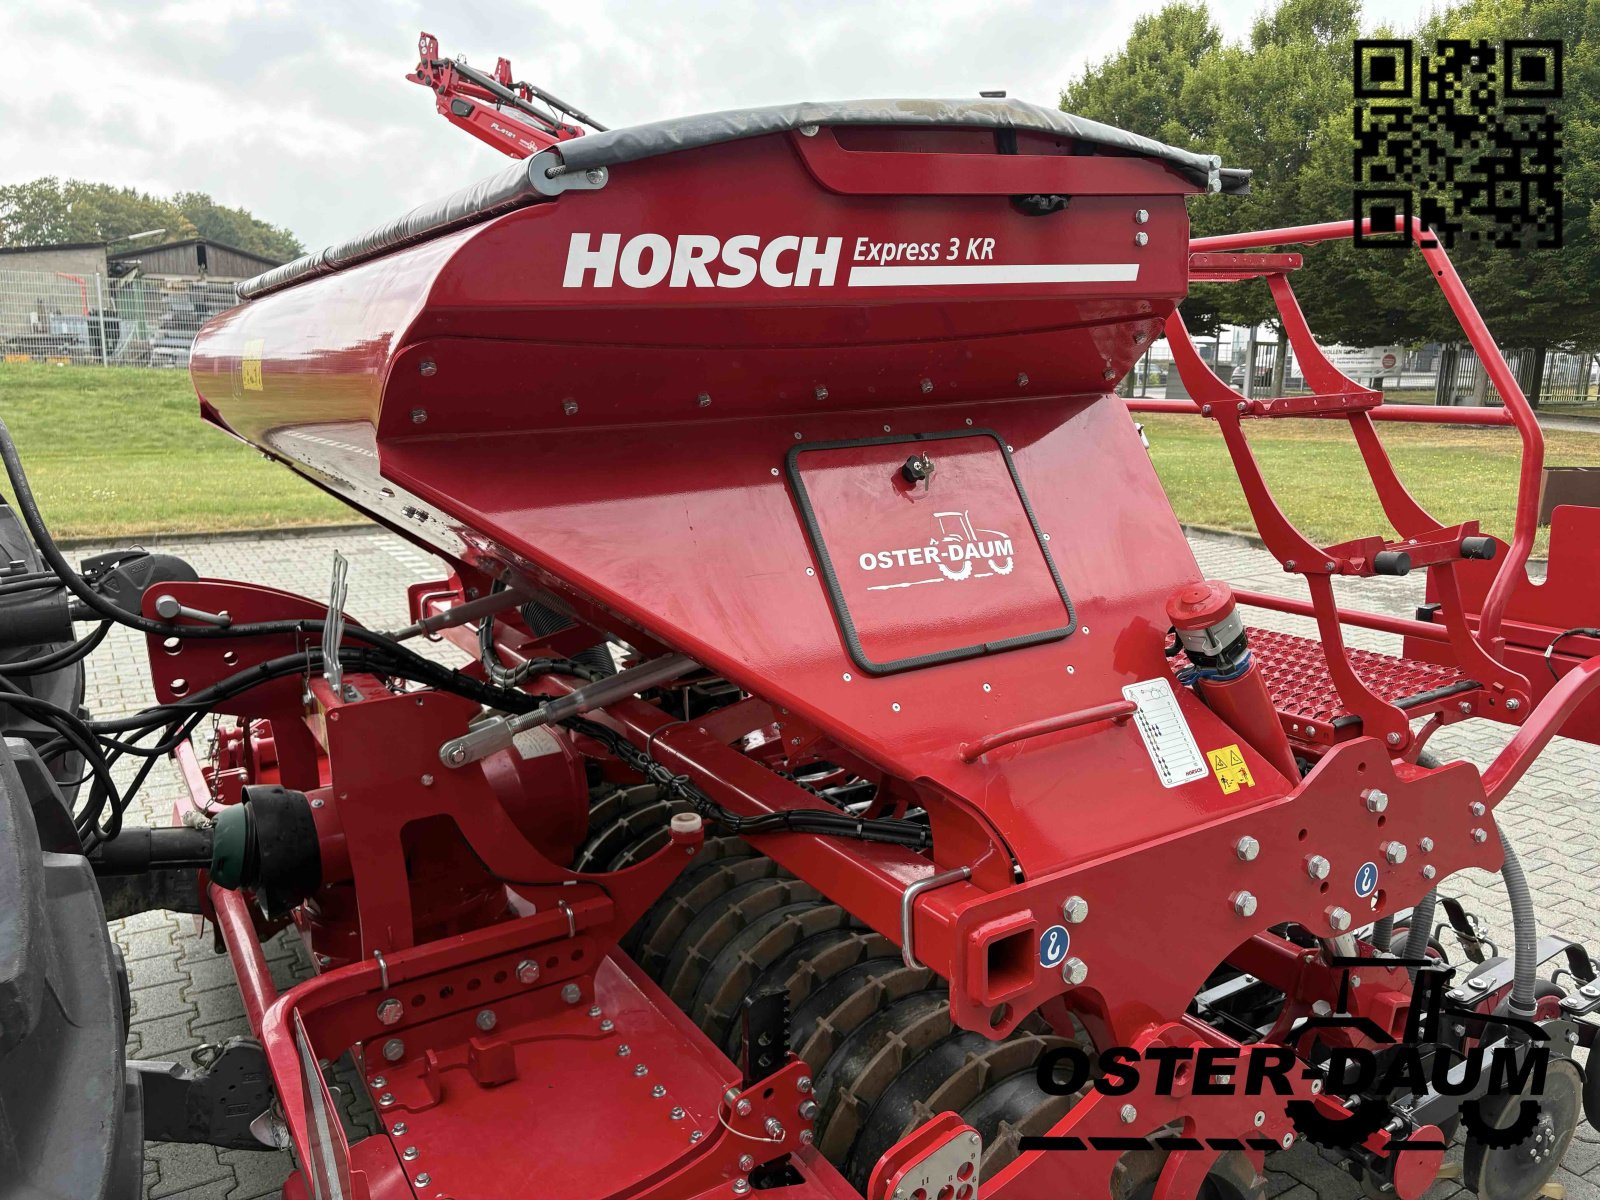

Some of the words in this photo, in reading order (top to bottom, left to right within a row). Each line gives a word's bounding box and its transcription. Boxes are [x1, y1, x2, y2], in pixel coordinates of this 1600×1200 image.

[563, 233, 843, 289] HORSCH
[853, 237, 941, 265] Express
[946, 237, 960, 261] 3
[966, 237, 996, 260] KR
[859, 539, 1014, 571] OSTER-DAUM
[1185, 767, 1203, 777] HORSCH
